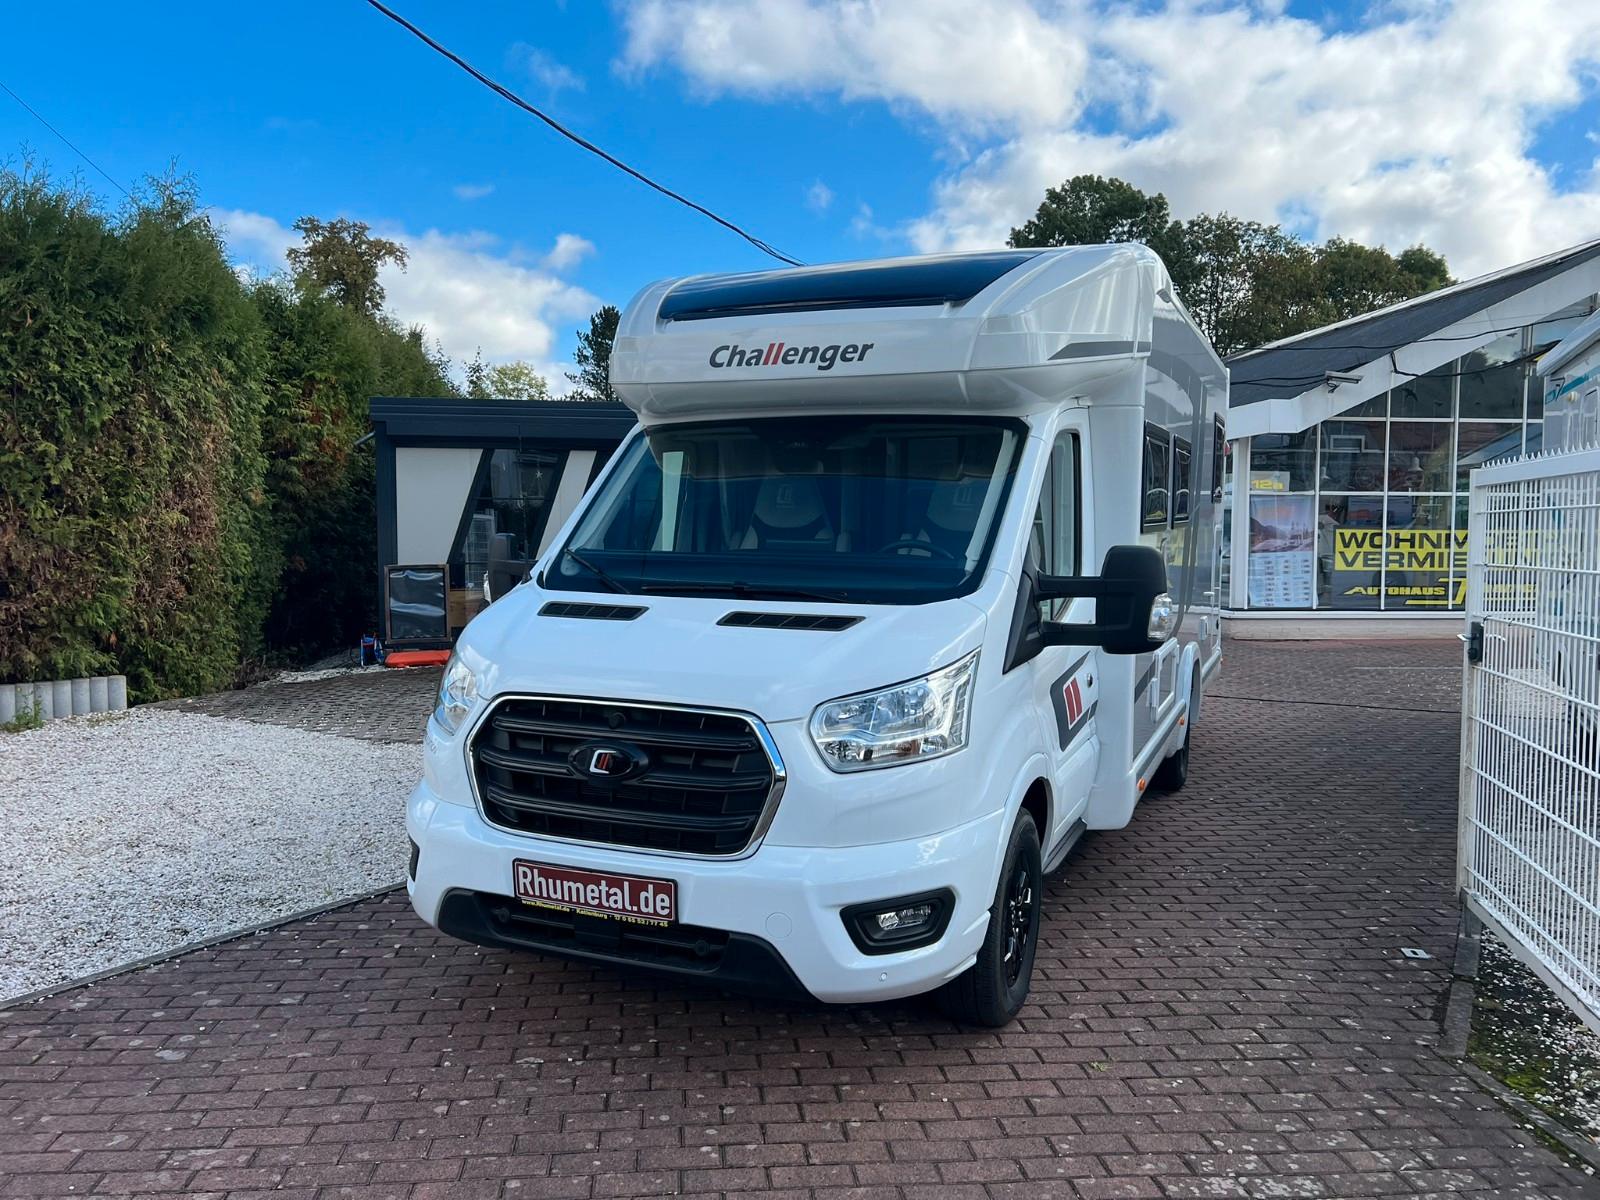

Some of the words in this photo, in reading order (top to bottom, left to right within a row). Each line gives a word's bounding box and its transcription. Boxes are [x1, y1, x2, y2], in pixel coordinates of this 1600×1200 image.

[709, 342, 875, 371] Challenger
[1339, 531, 1468, 549] WOHNM
[1339, 551, 1467, 568] VERMIE
[517, 866, 671, 916] Rhumetal.de
